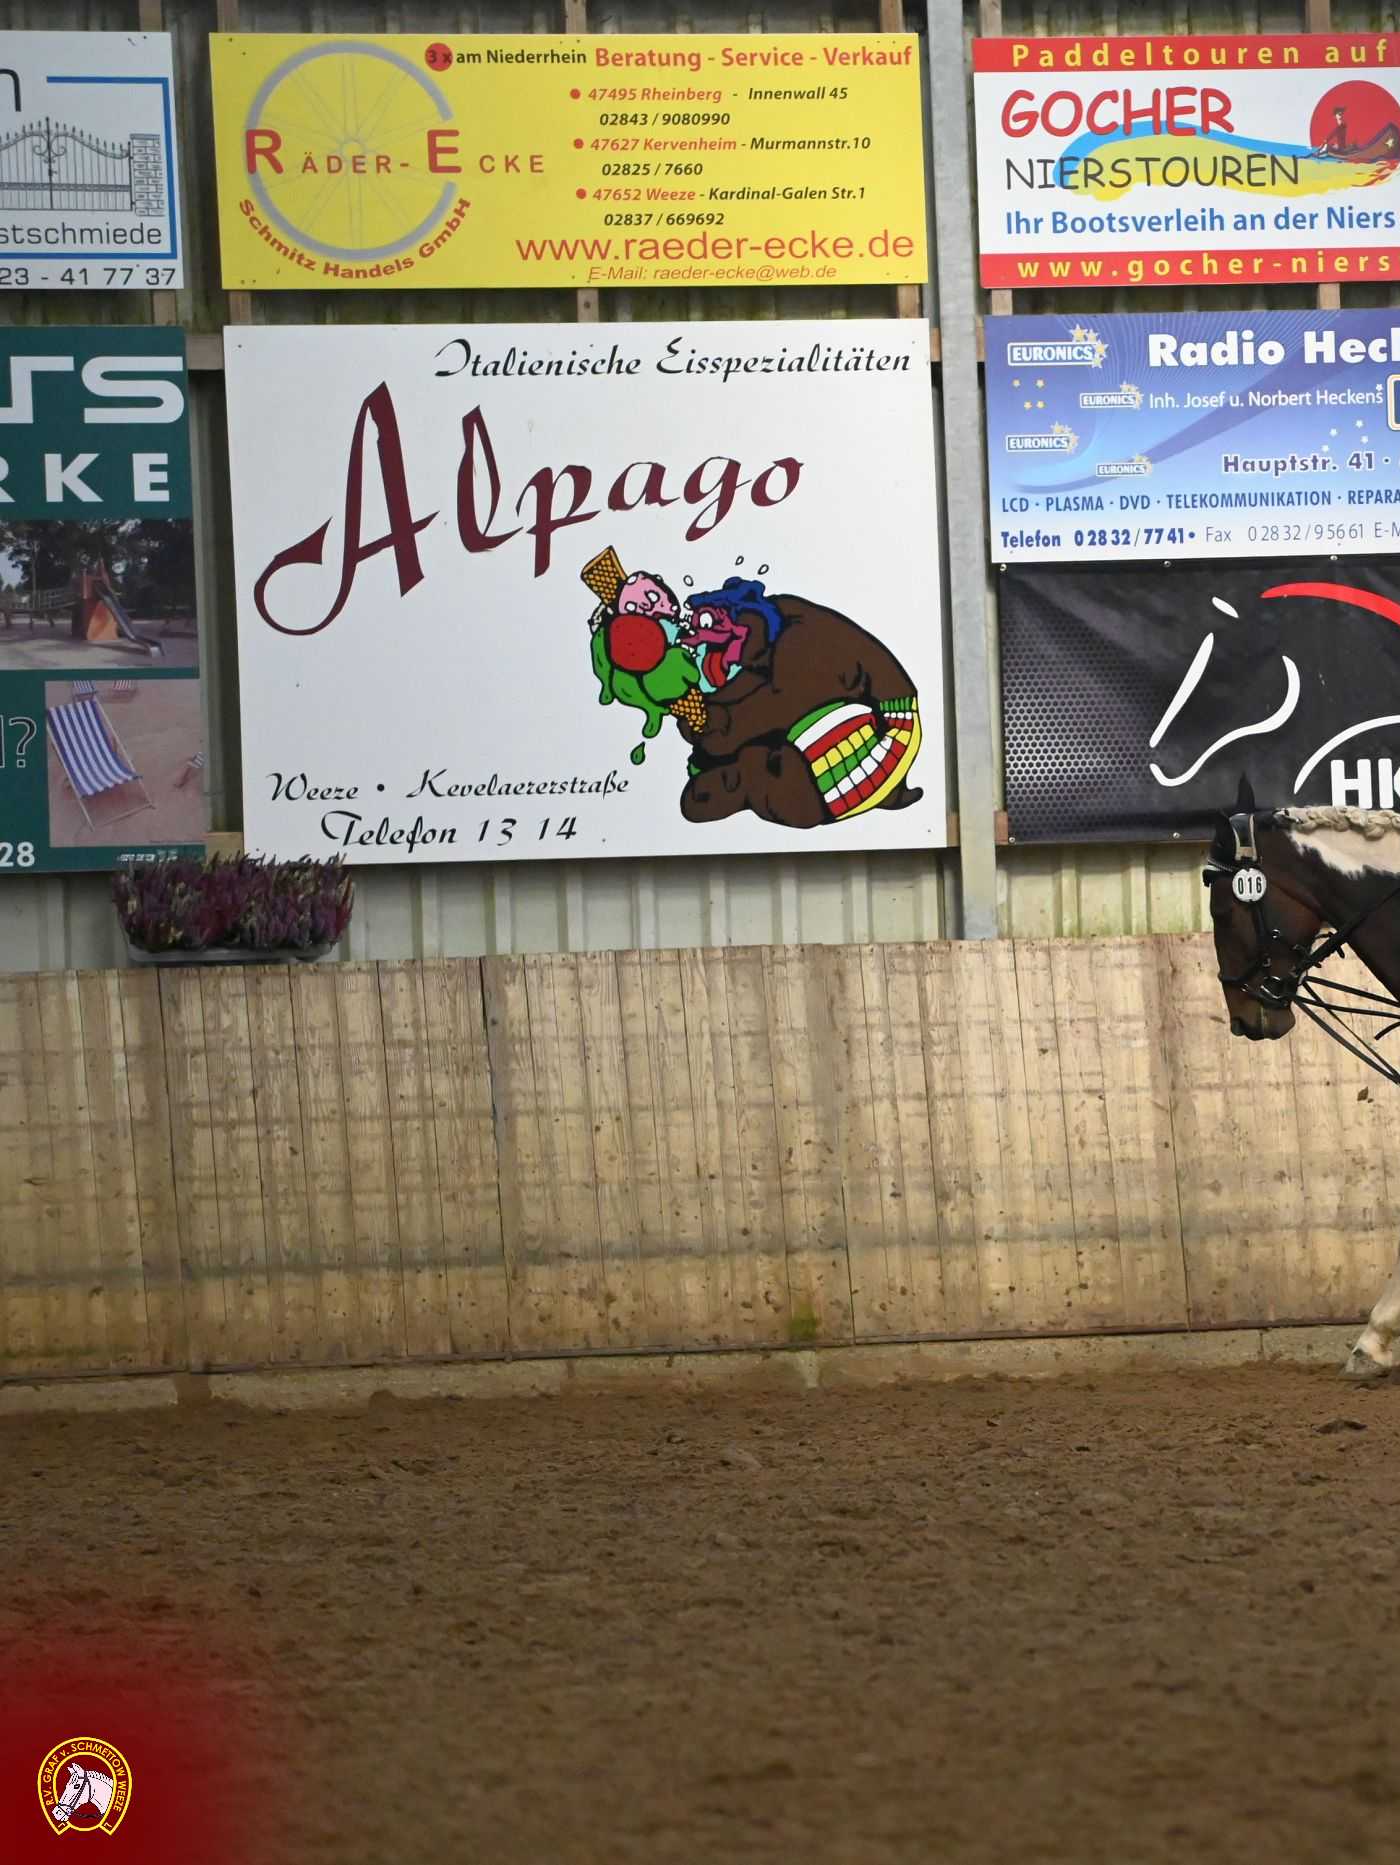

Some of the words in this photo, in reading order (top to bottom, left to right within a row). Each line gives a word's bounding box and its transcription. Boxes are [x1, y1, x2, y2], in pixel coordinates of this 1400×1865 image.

[456, 52, 482, 64] am
[486, 49, 587, 64] Niederrhein
[595, 48, 701, 72] Beratung
[721, 47, 804, 66] Service
[823, 45, 913, 66] Verkauf
[1012, 42, 1300, 67] Paddeltouren
[1325, 38, 1389, 63] auf
[588, 88, 636, 101] 47495
[640, 87, 722, 103] Rheinberg
[748, 87, 826, 100] Innenwall
[829, 88, 849, 100] 45
[599, 113, 648, 126] 02843
[661, 113, 731, 126] 9080990
[1001, 86, 1235, 137] GOCHER
[590, 138, 640, 151] 47627
[643, 138, 737, 151] Kervenheim
[601, 163, 651, 176] 02825
[664, 163, 703, 176] 7660
[1006, 154, 1299, 190] NIERSTOUREN
[592, 188, 641, 202] 47652
[646, 188, 696, 201] Weeze
[709, 186, 828, 201] Kardinal-Galen
[604, 213, 653, 226] 02837
[666, 213, 725, 226] 669692
[1006, 210, 1043, 234] Ihr
[1052, 207, 1225, 234] Bootsverleih
[1233, 213, 1266, 232] an
[1274, 206, 1318, 230] der
[1327, 205, 1396, 229] Niers
[239, 199, 316, 272] Schmitz
[322, 257, 415, 279] Handels
[418, 197, 472, 258] GmbH
[515, 229, 914, 262] www.raeder-ecke.de
[60, 268, 88, 285] 41
[104, 267, 133, 285] 77
[146, 268, 176, 286] 37
[588, 266, 649, 281] E-Mail:
[653, 265, 837, 282] raeder-ecke@web.de
[1012, 345, 1093, 362] EURONICS
[1148, 330, 1286, 367] Radio
[434, 338, 641, 377] Italienische
[657, 337, 910, 382] Eisspezialitäten
[1083, 394, 1135, 406] EURONICS
[1150, 394, 1179, 408] Inh.
[1183, 392, 1225, 408] Josef
[1230, 396, 1244, 407] u.
[1248, 390, 1312, 407] Norbert
[1316, 389, 1383, 405] Heckens
[1009, 437, 1068, 449] EURONICS
[1099, 465, 1146, 475] EURONICS
[1222, 452, 1338, 478] Hauptstr.
[1348, 451, 1374, 471] 41
[253, 380, 804, 637] Alpago
[1002, 497, 1029, 512] LCD
[1046, 496, 1104, 512] PLASMA
[1120, 494, 1150, 511] DVD
[1166, 490, 1332, 509] TELEKOMMUNIKATION
[1002, 531, 1061, 548] Telefon
[1205, 527, 1232, 543] Fax
[266, 772, 359, 801] Weeze
[321, 810, 457, 853] Telefon
[478, 818, 517, 846] 13
[539, 815, 577, 841] 14
[1237, 877, 1262, 895] 016
